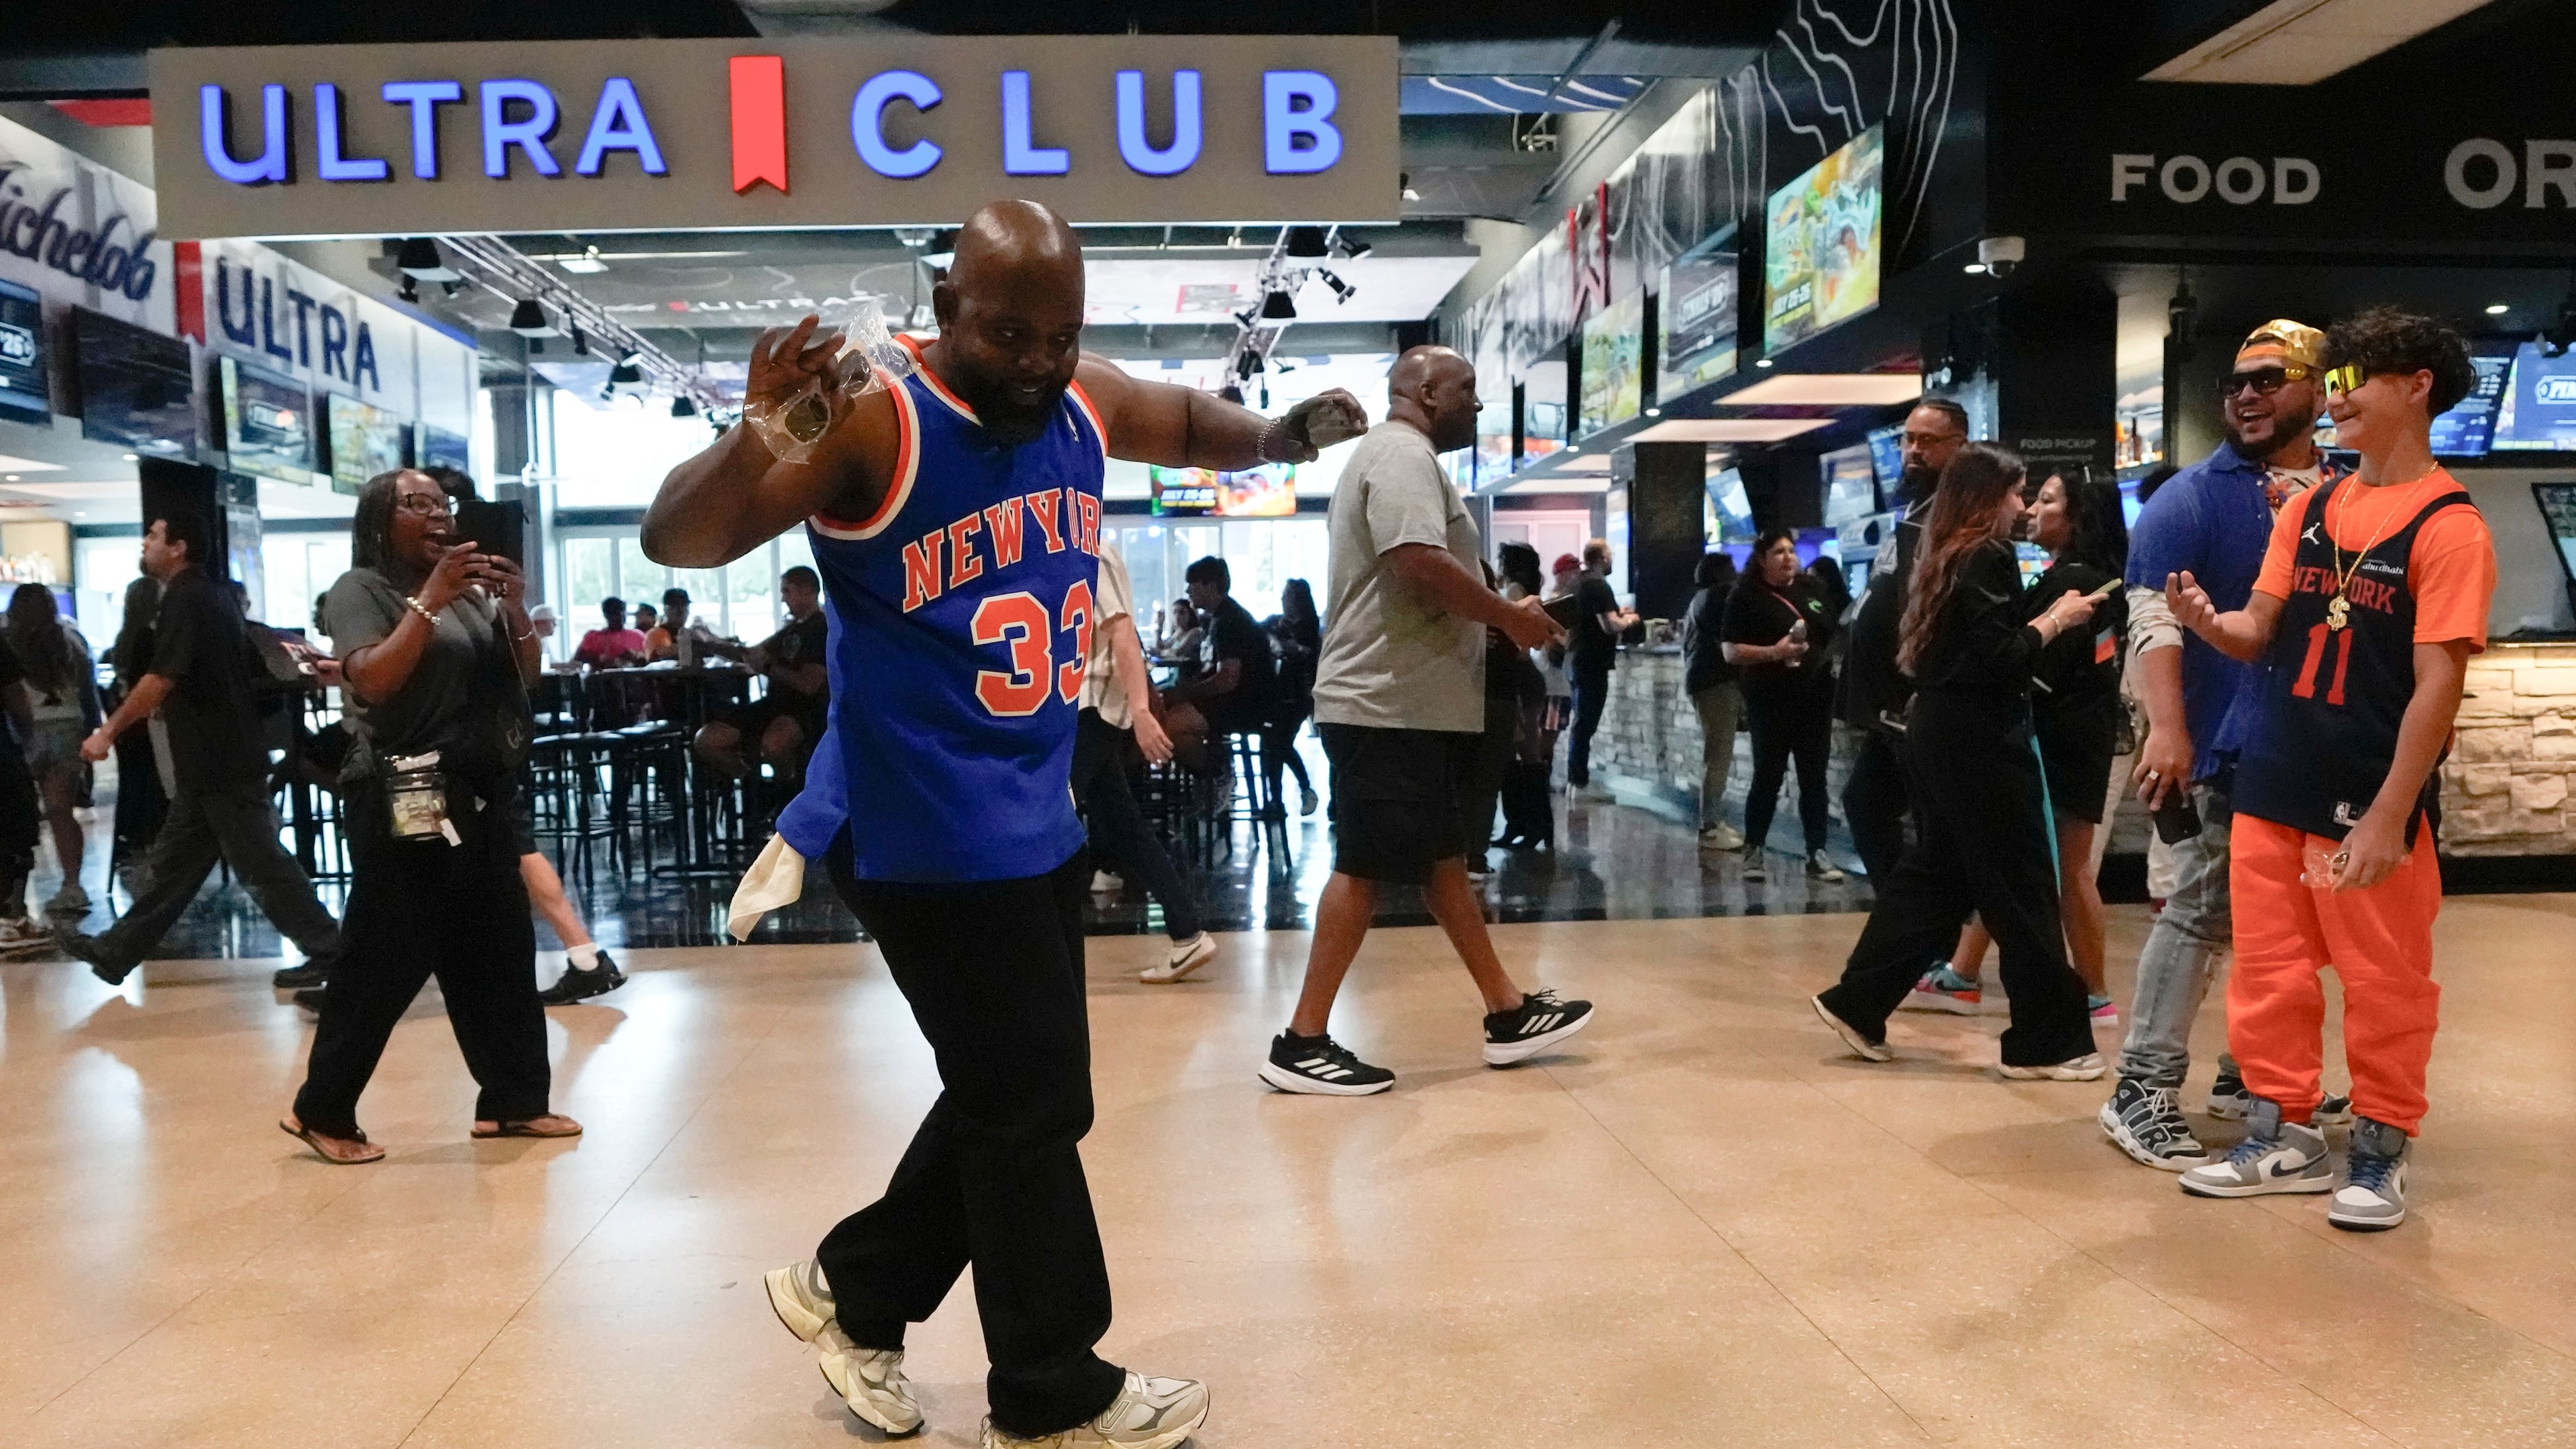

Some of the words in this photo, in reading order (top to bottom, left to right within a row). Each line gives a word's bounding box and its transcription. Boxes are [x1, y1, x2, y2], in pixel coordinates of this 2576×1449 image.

[201, 77, 667, 183] ULTRA
[850, 68, 1343, 178] CLUB
[2110, 154, 2321, 205] FOOD
[0, 160, 158, 301] ichelob
[216, 255, 380, 393] ULTRA
[970, 578, 1094, 717] 33
[2291, 623, 2354, 706] 11
